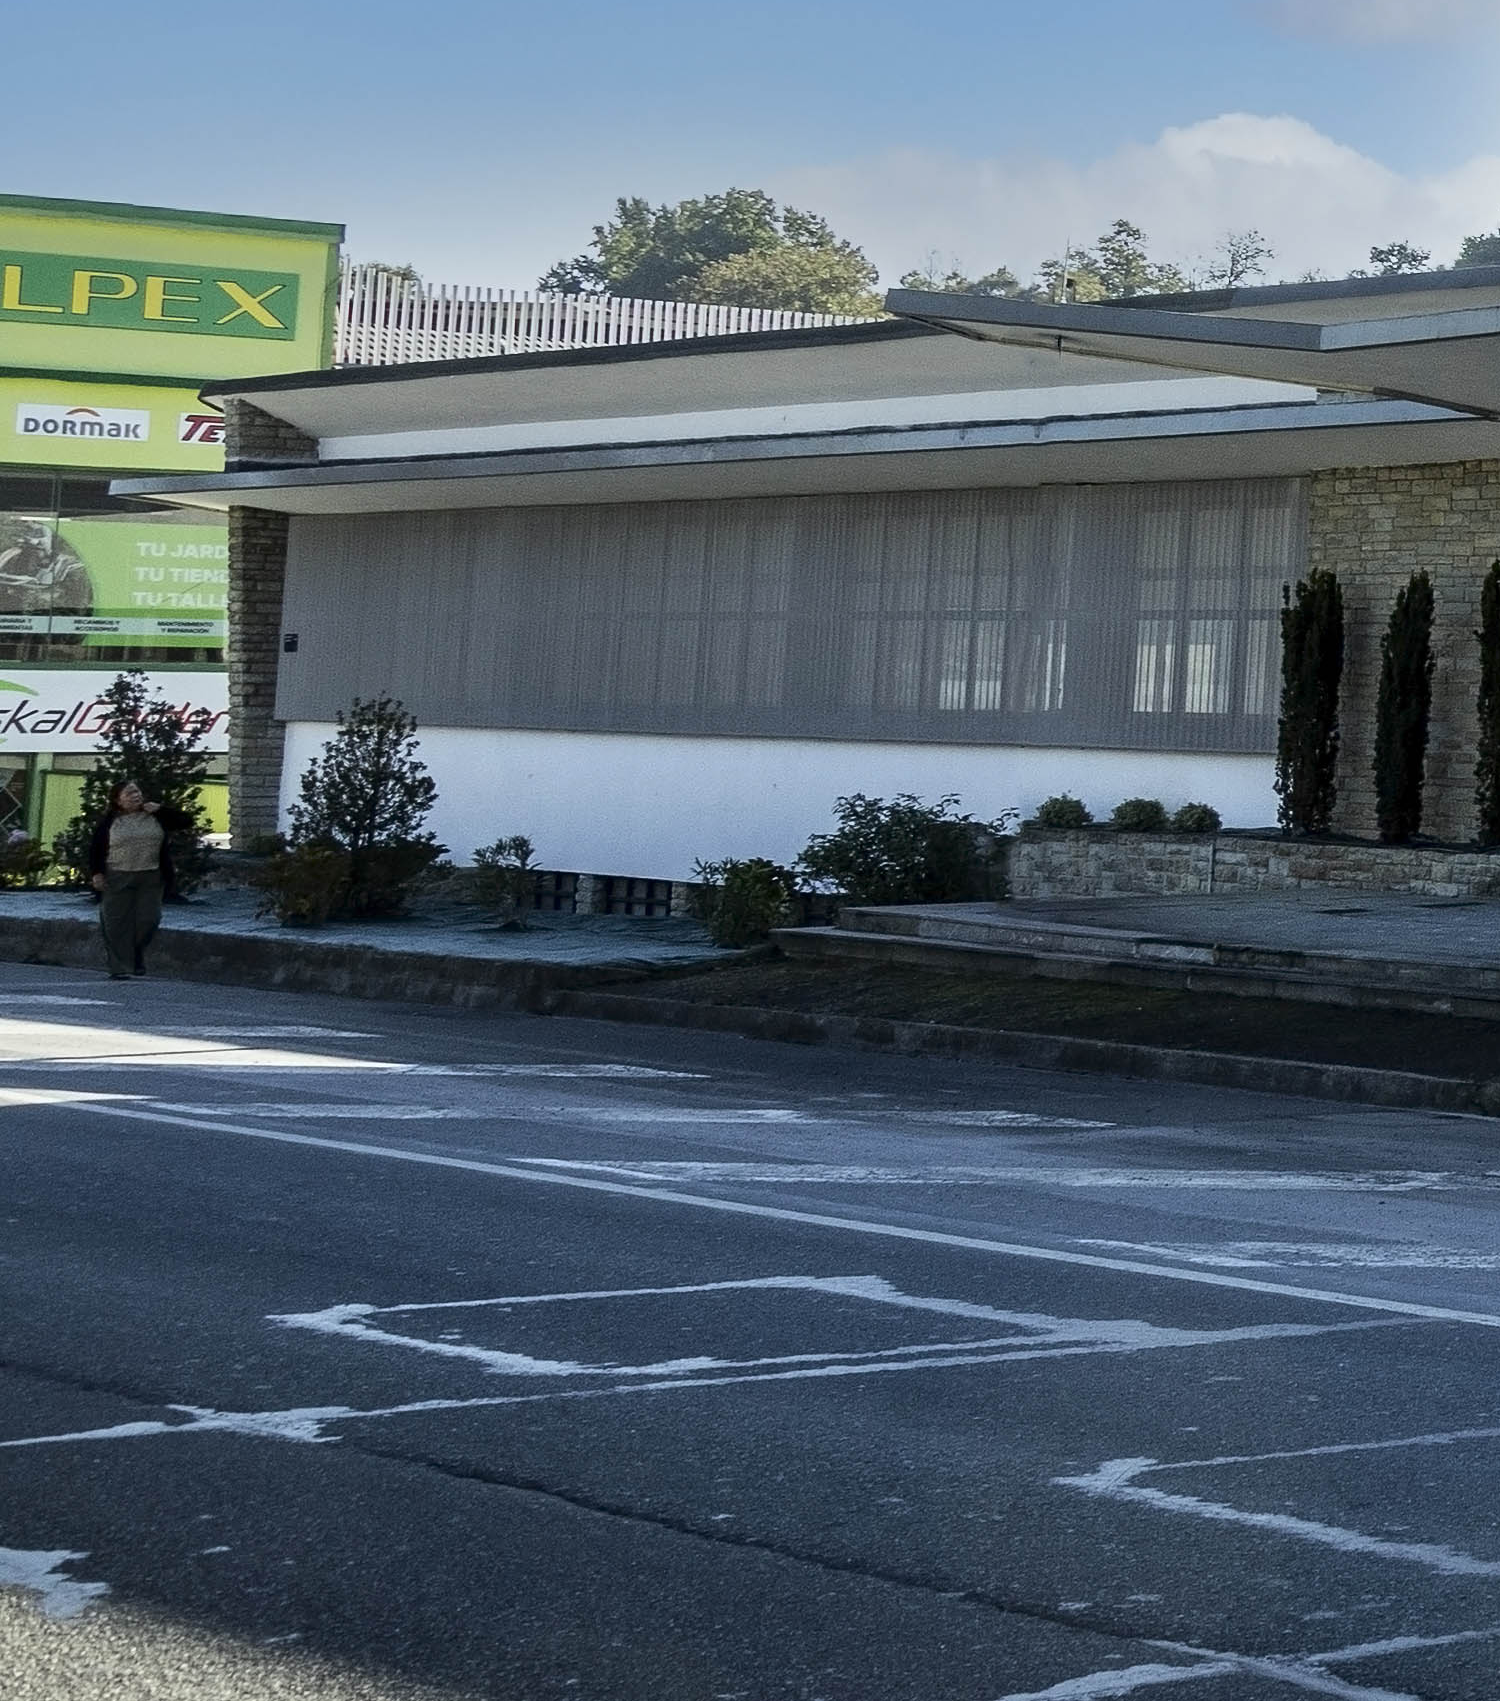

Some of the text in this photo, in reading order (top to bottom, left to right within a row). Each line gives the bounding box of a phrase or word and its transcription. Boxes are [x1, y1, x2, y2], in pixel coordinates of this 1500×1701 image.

[181, 414, 226, 443] TE
[136, 542, 166, 557] TU
[135, 567, 165, 582] TU
[132, 591, 163, 607] TU
